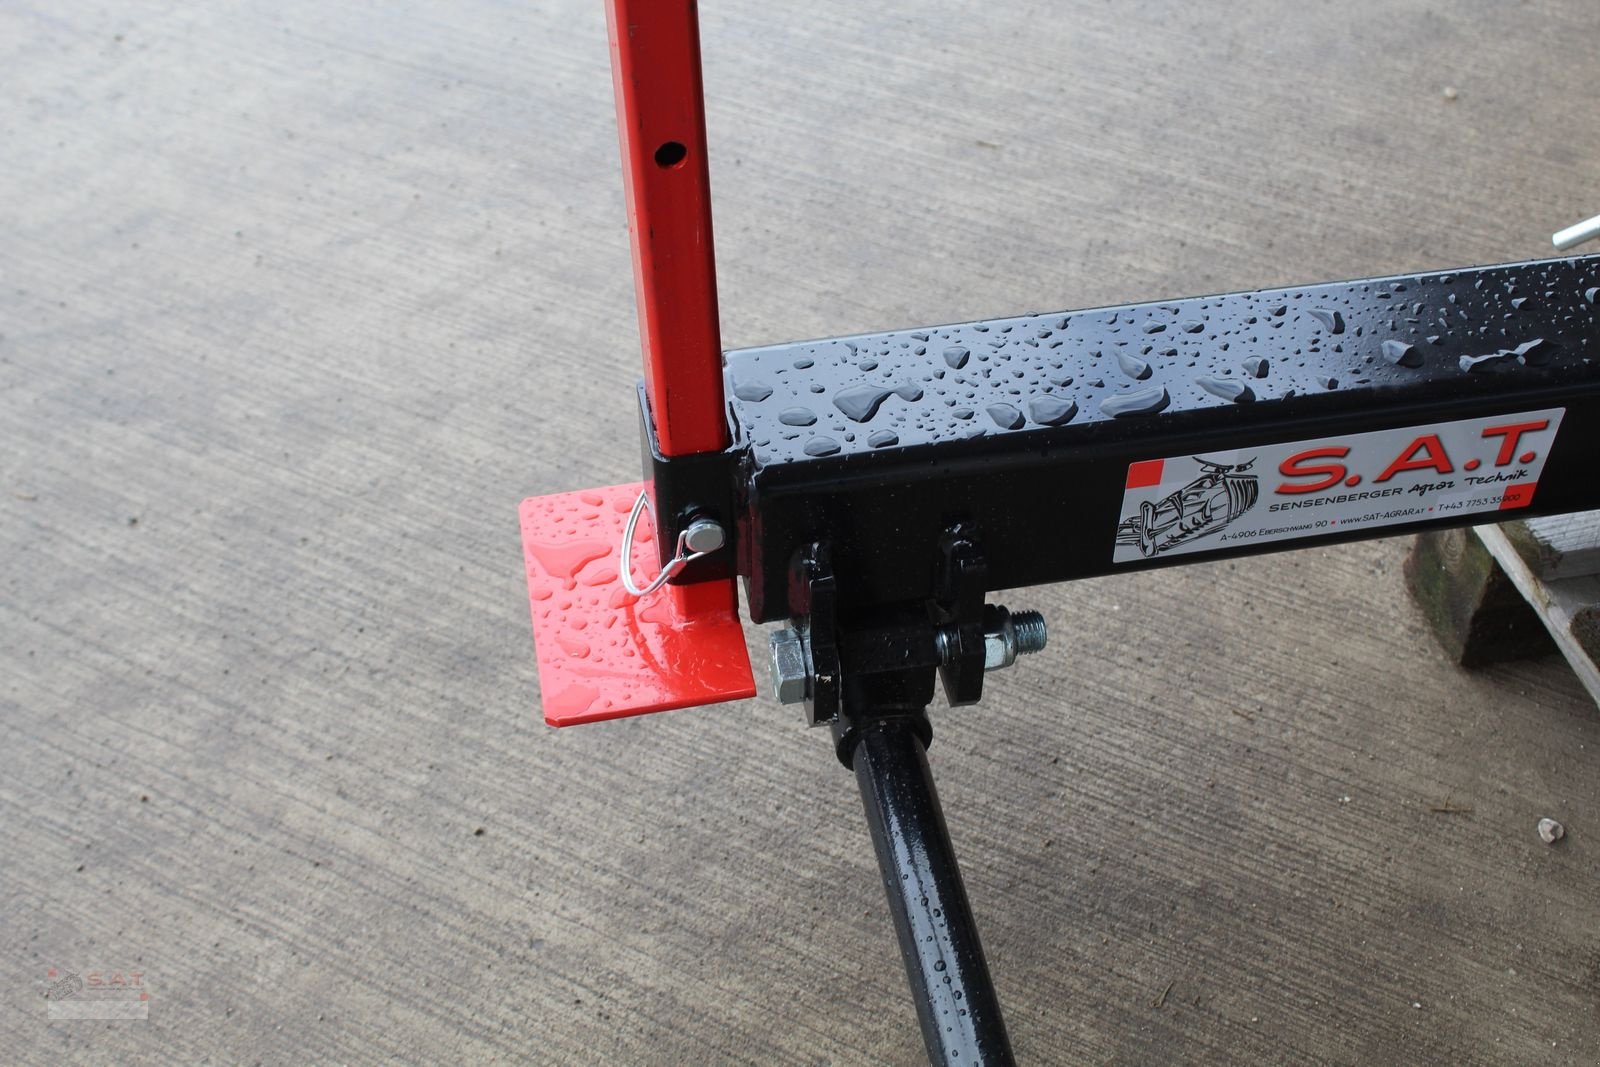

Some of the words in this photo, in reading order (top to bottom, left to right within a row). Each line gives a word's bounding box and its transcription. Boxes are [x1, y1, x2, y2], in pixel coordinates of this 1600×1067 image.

[1269, 487, 1403, 513] SENSENBERGER
[1408, 481, 1456, 497] Agrar
[1464, 469, 1529, 486] Technik
[1220, 530, 1257, 541] A-4906
[1315, 519, 1328, 528] 90
[1439, 501, 1463, 511] T+43
[1466, 498, 1488, 508] 7753
